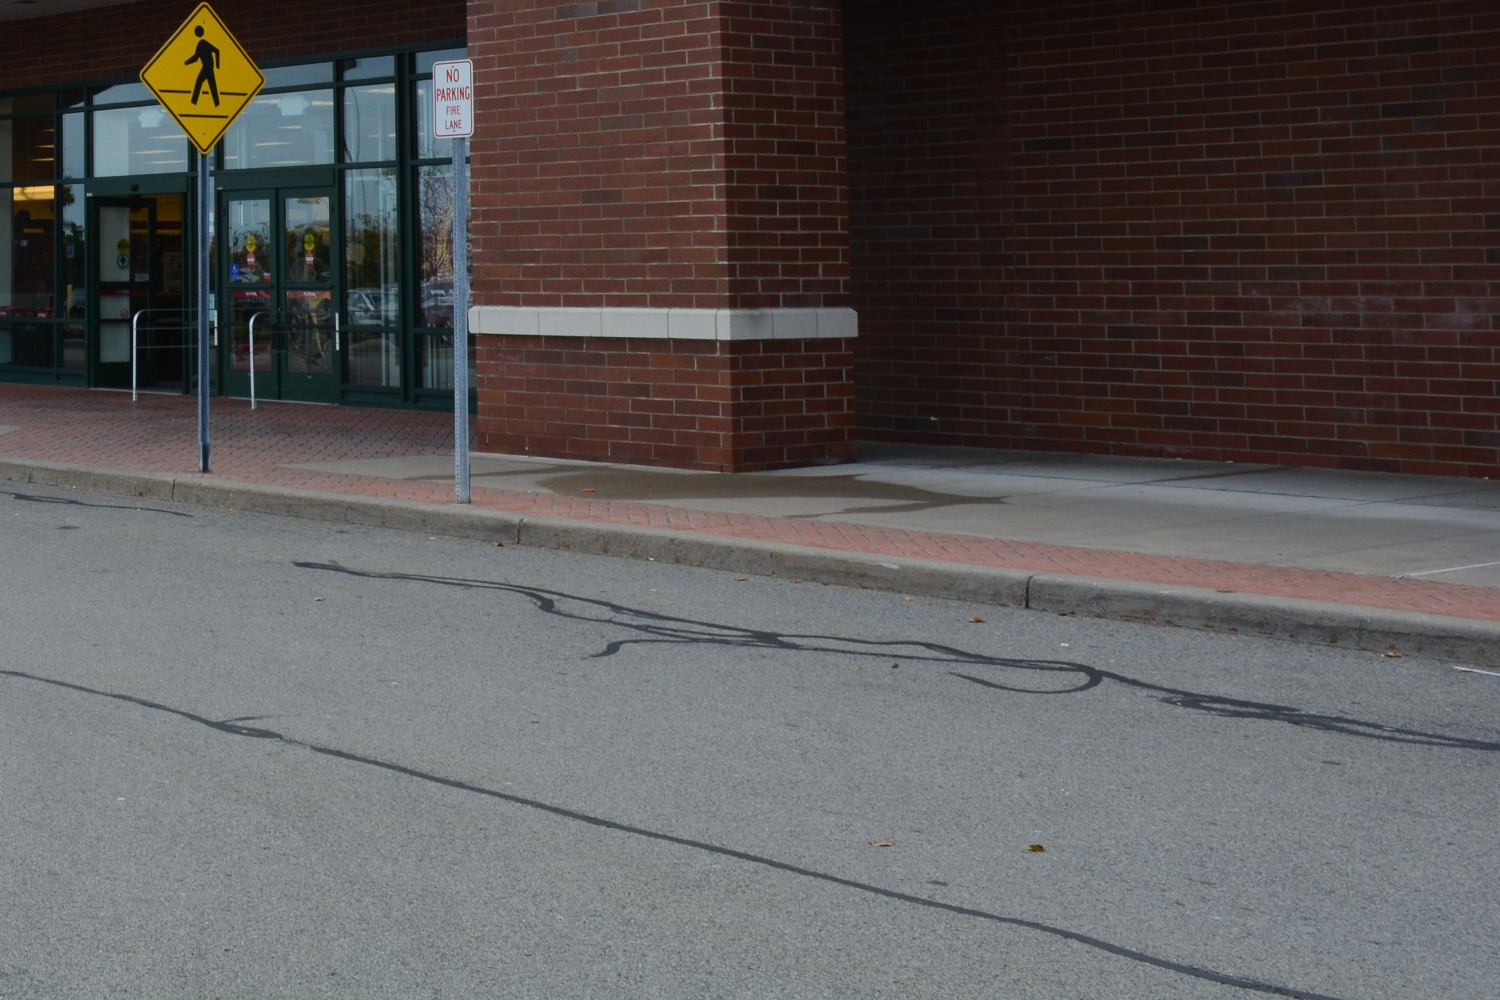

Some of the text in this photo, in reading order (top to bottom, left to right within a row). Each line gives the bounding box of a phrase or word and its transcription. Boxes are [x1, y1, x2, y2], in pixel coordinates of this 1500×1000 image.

[446, 68, 460, 83] NO
[436, 86, 471, 102] PARKING
[446, 105, 461, 116] FIRE
[444, 120, 463, 130] LANE
